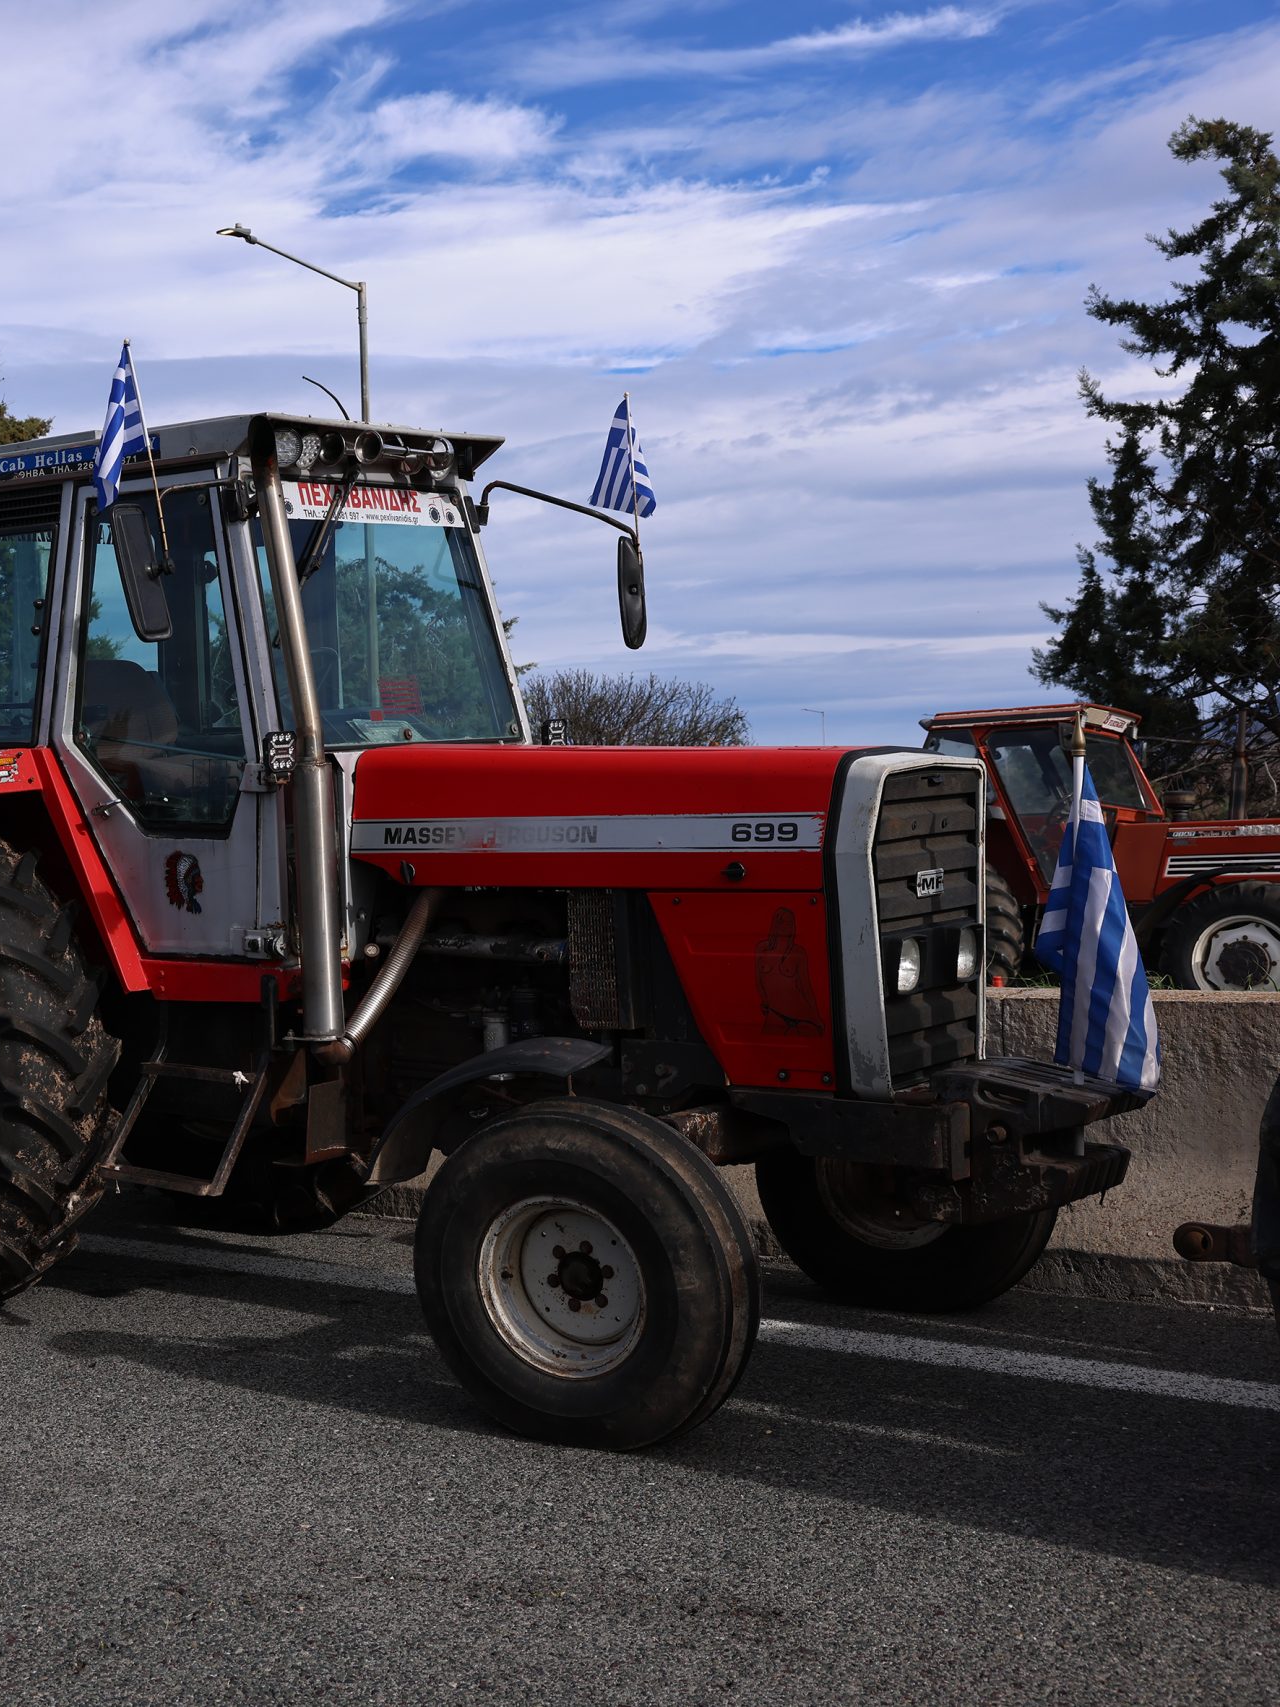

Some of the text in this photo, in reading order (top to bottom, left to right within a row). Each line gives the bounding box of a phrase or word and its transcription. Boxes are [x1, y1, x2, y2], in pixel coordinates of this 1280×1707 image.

[0, 450, 83, 473] Cab Hellas
[297, 482, 422, 513] ΠΕΧΒΑΝΙΔΗΣ
[384, 826, 466, 845] MASSEY
[731, 822, 799, 842] 699
[921, 875, 944, 892] MF
